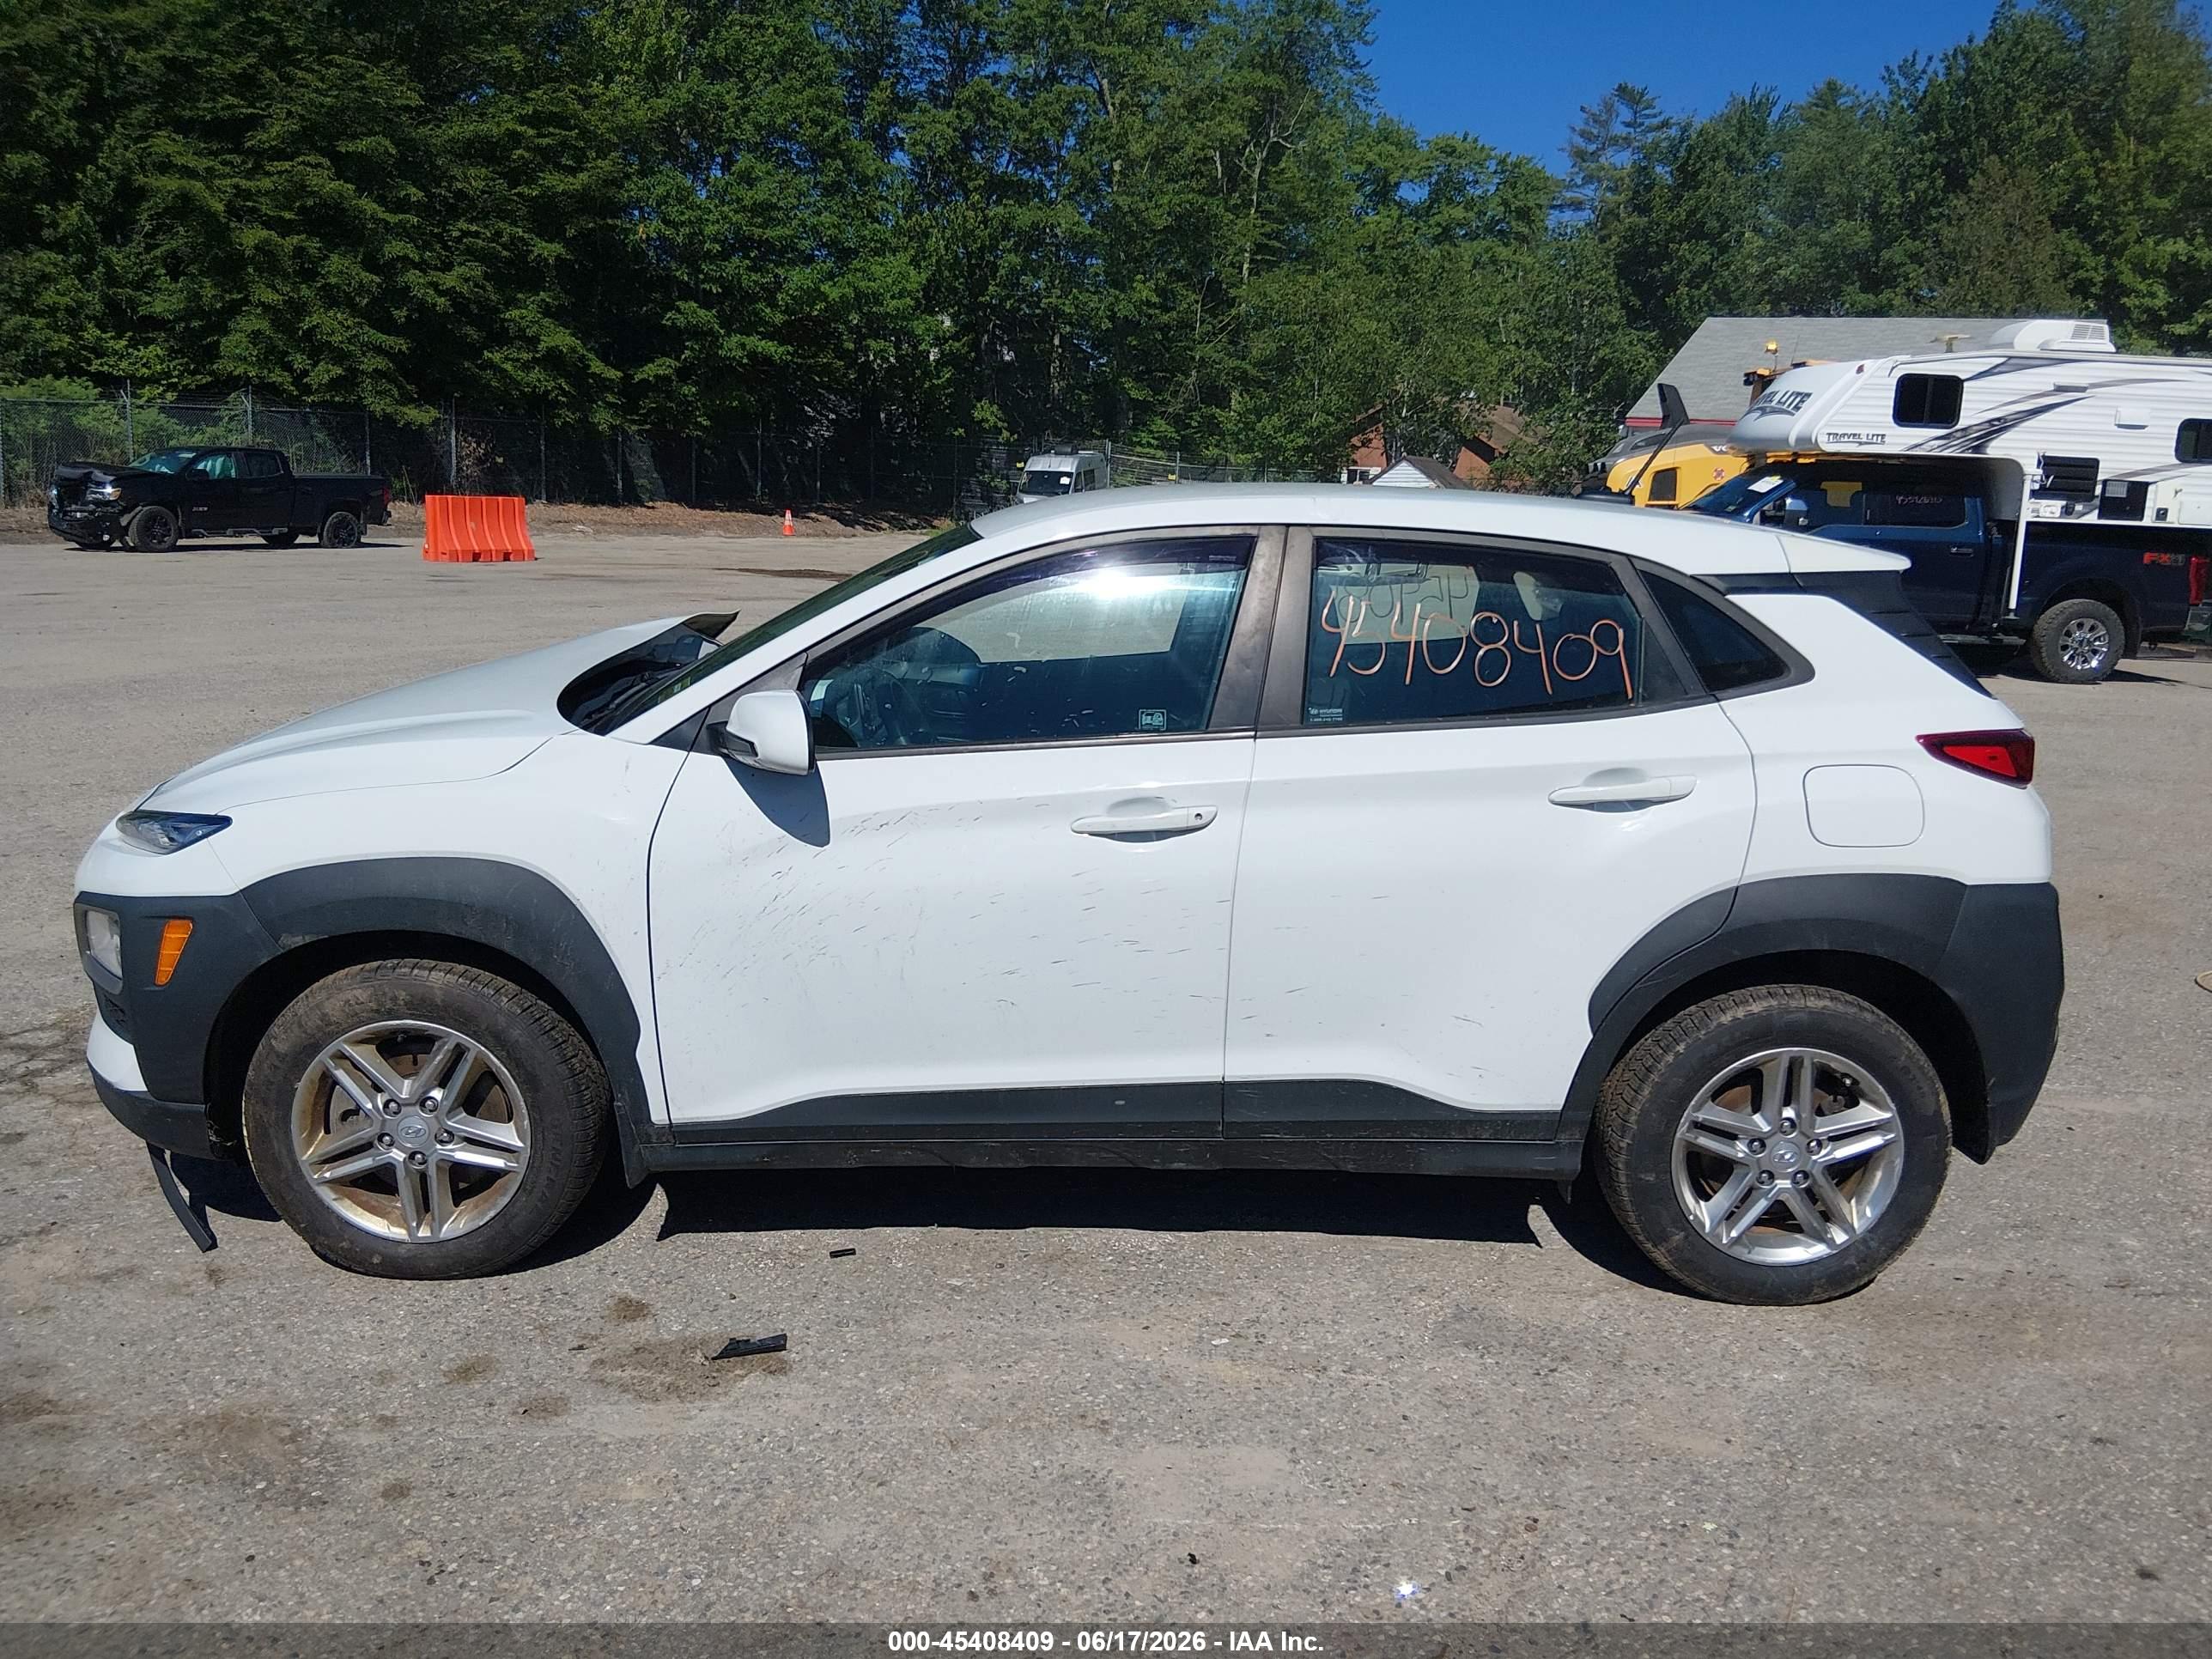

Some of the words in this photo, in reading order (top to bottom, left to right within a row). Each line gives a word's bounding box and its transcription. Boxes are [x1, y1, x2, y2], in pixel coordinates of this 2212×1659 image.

[1774, 390, 1814, 413] LITE
[1826, 432, 1863, 442] TRAVEL
[1866, 433, 1887, 444] LITE
[1322, 589, 1634, 700] 45408409
